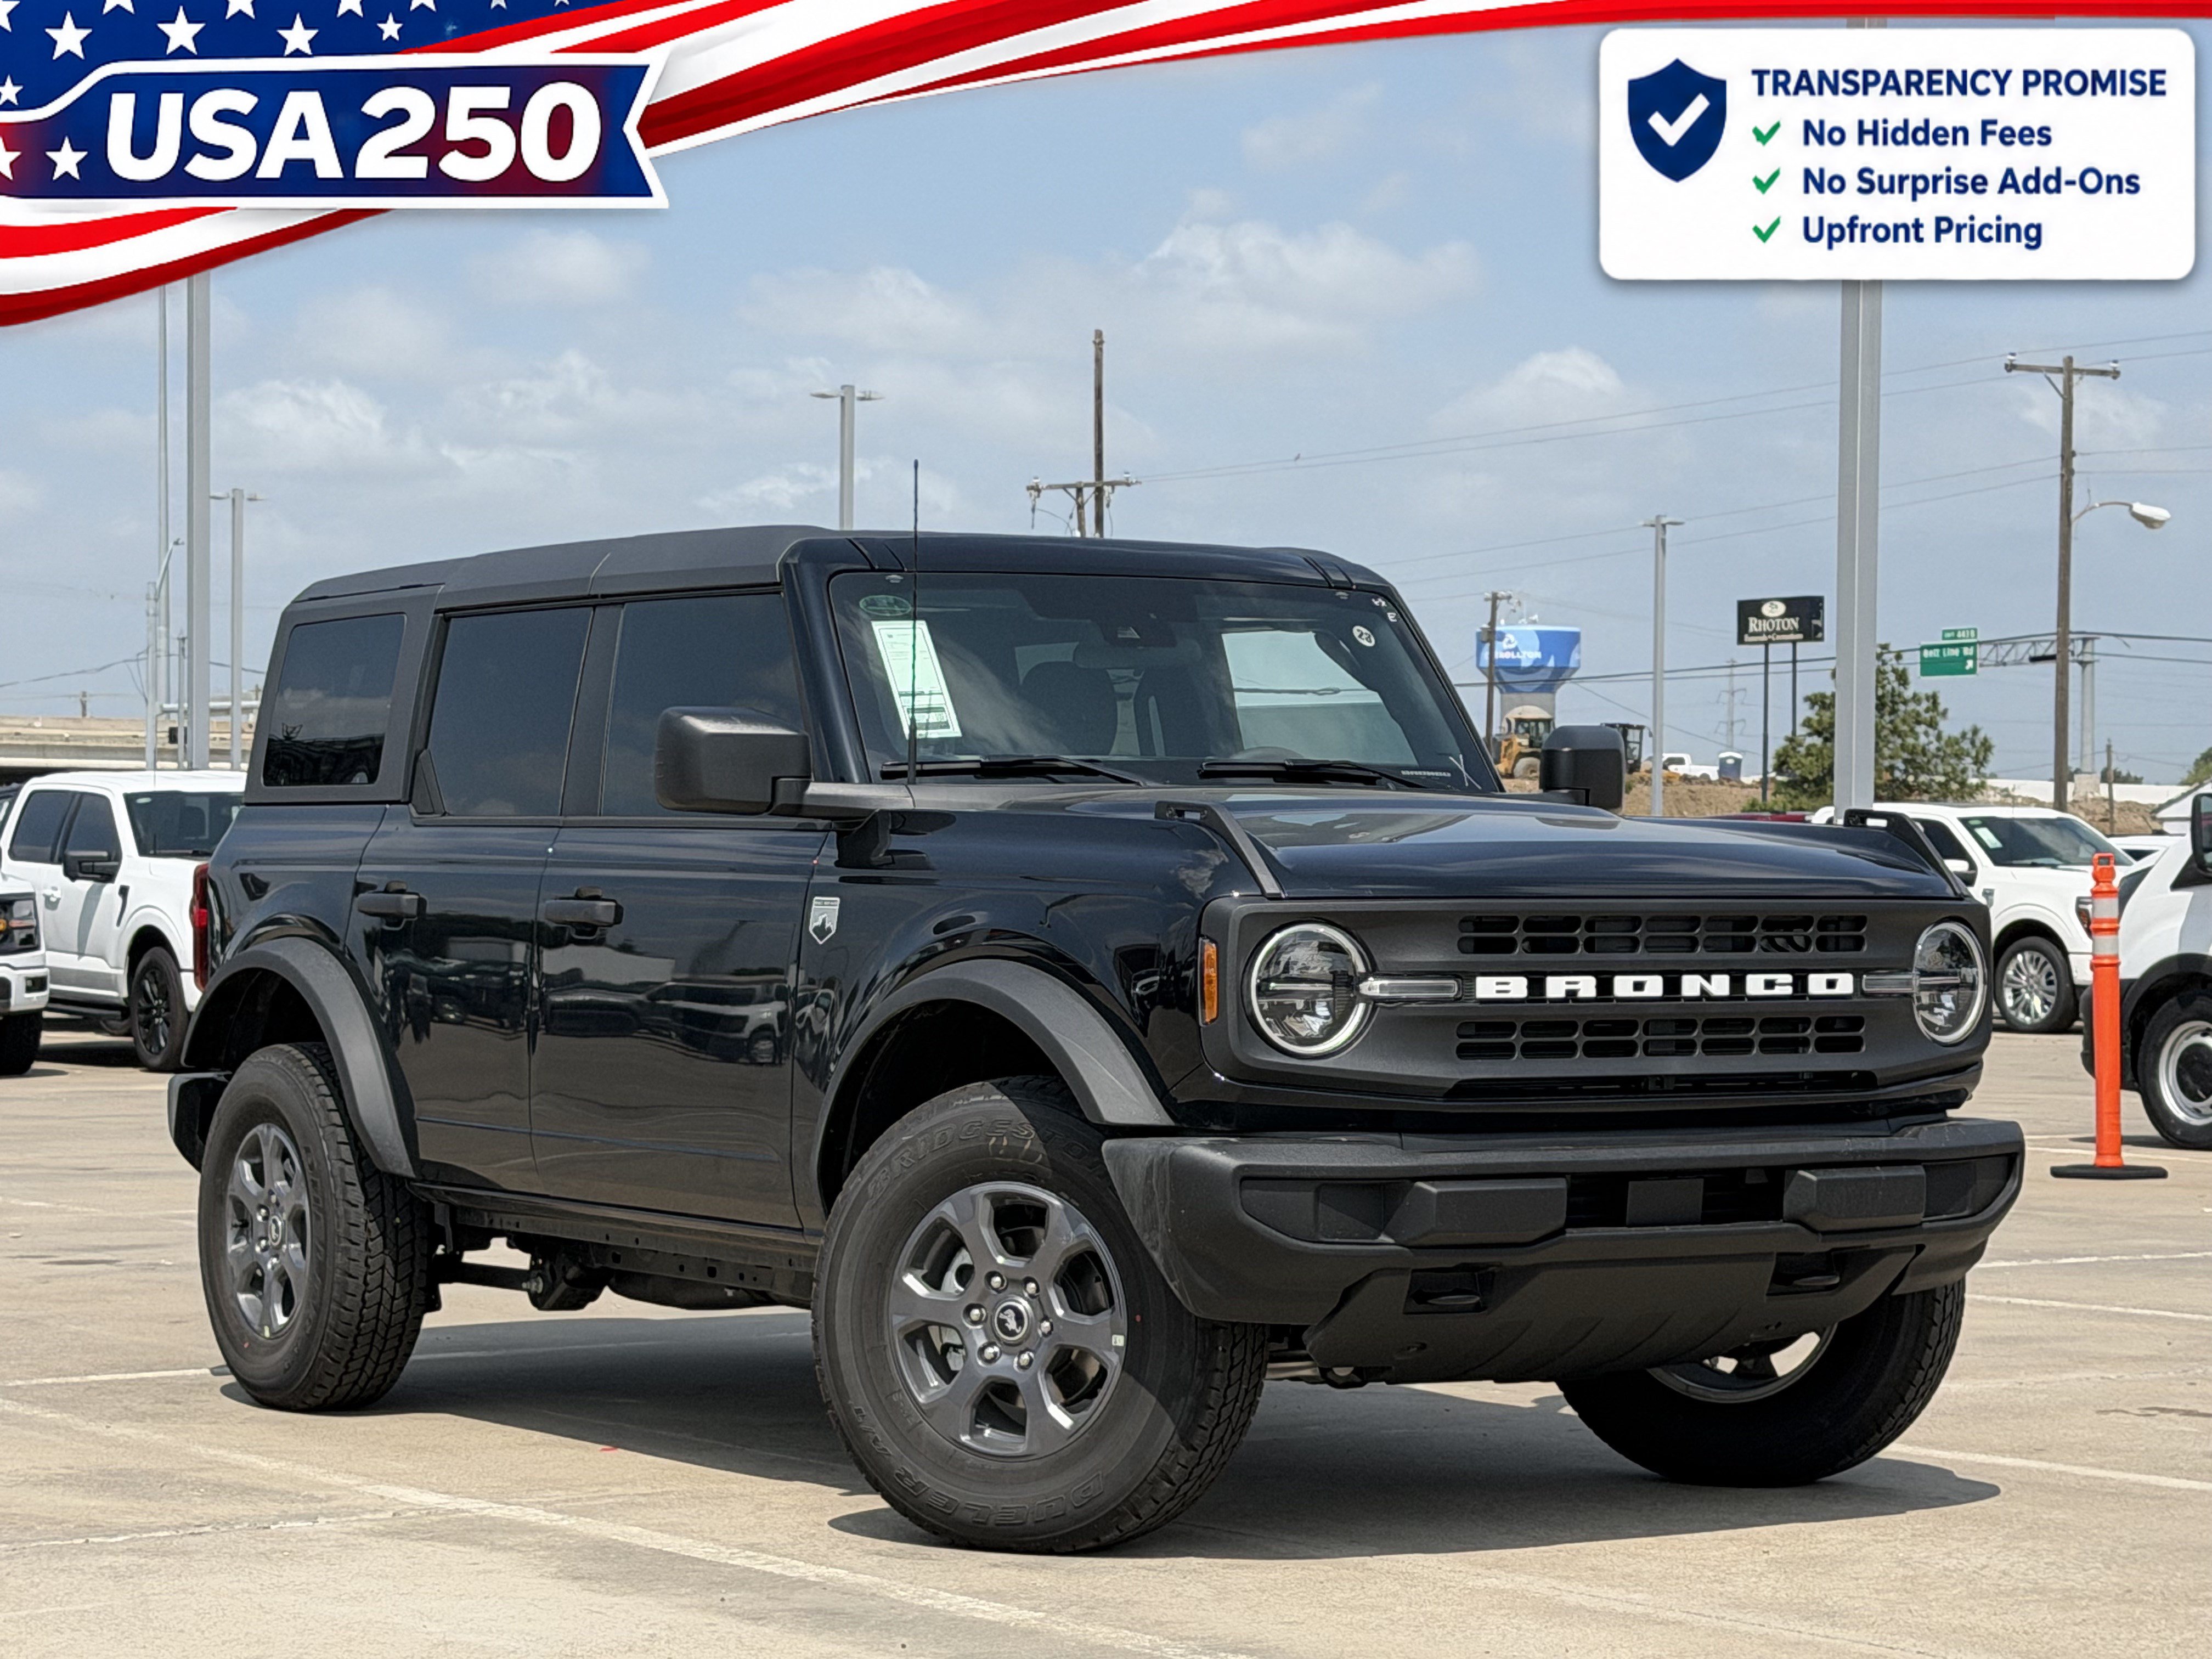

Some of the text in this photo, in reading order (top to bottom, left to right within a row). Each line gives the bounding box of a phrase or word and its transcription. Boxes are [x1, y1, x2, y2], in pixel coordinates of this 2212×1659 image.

[1747, 617, 1801, 633] RHOTON
[1475, 973, 1854, 998] BRONCO
[894, 1466, 1104, 1525] DUELER
